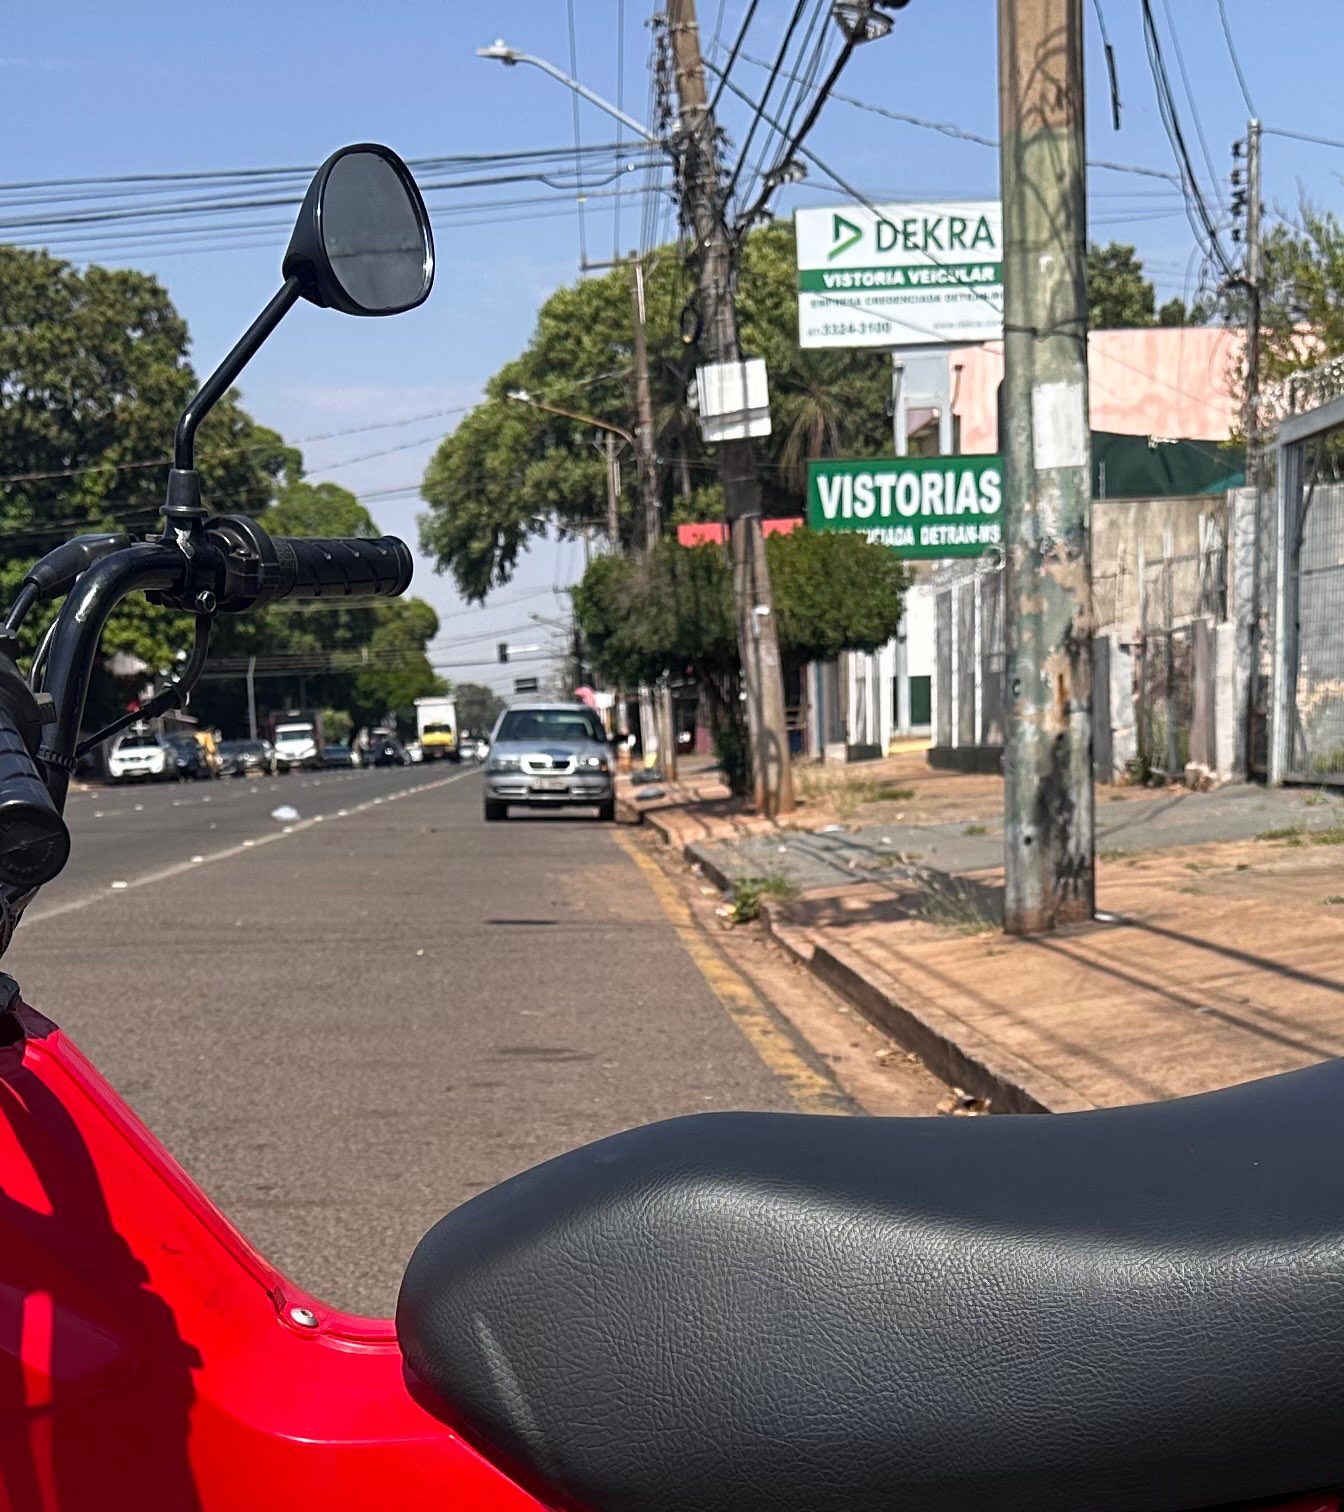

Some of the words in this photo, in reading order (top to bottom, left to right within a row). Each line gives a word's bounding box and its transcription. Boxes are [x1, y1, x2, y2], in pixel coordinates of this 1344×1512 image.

[875, 216, 996, 252] DEKRA
[822, 269, 905, 288] VISTORIA
[906, 266, 996, 285] VEICULAR
[816, 468, 1002, 519] VISTORIAS
